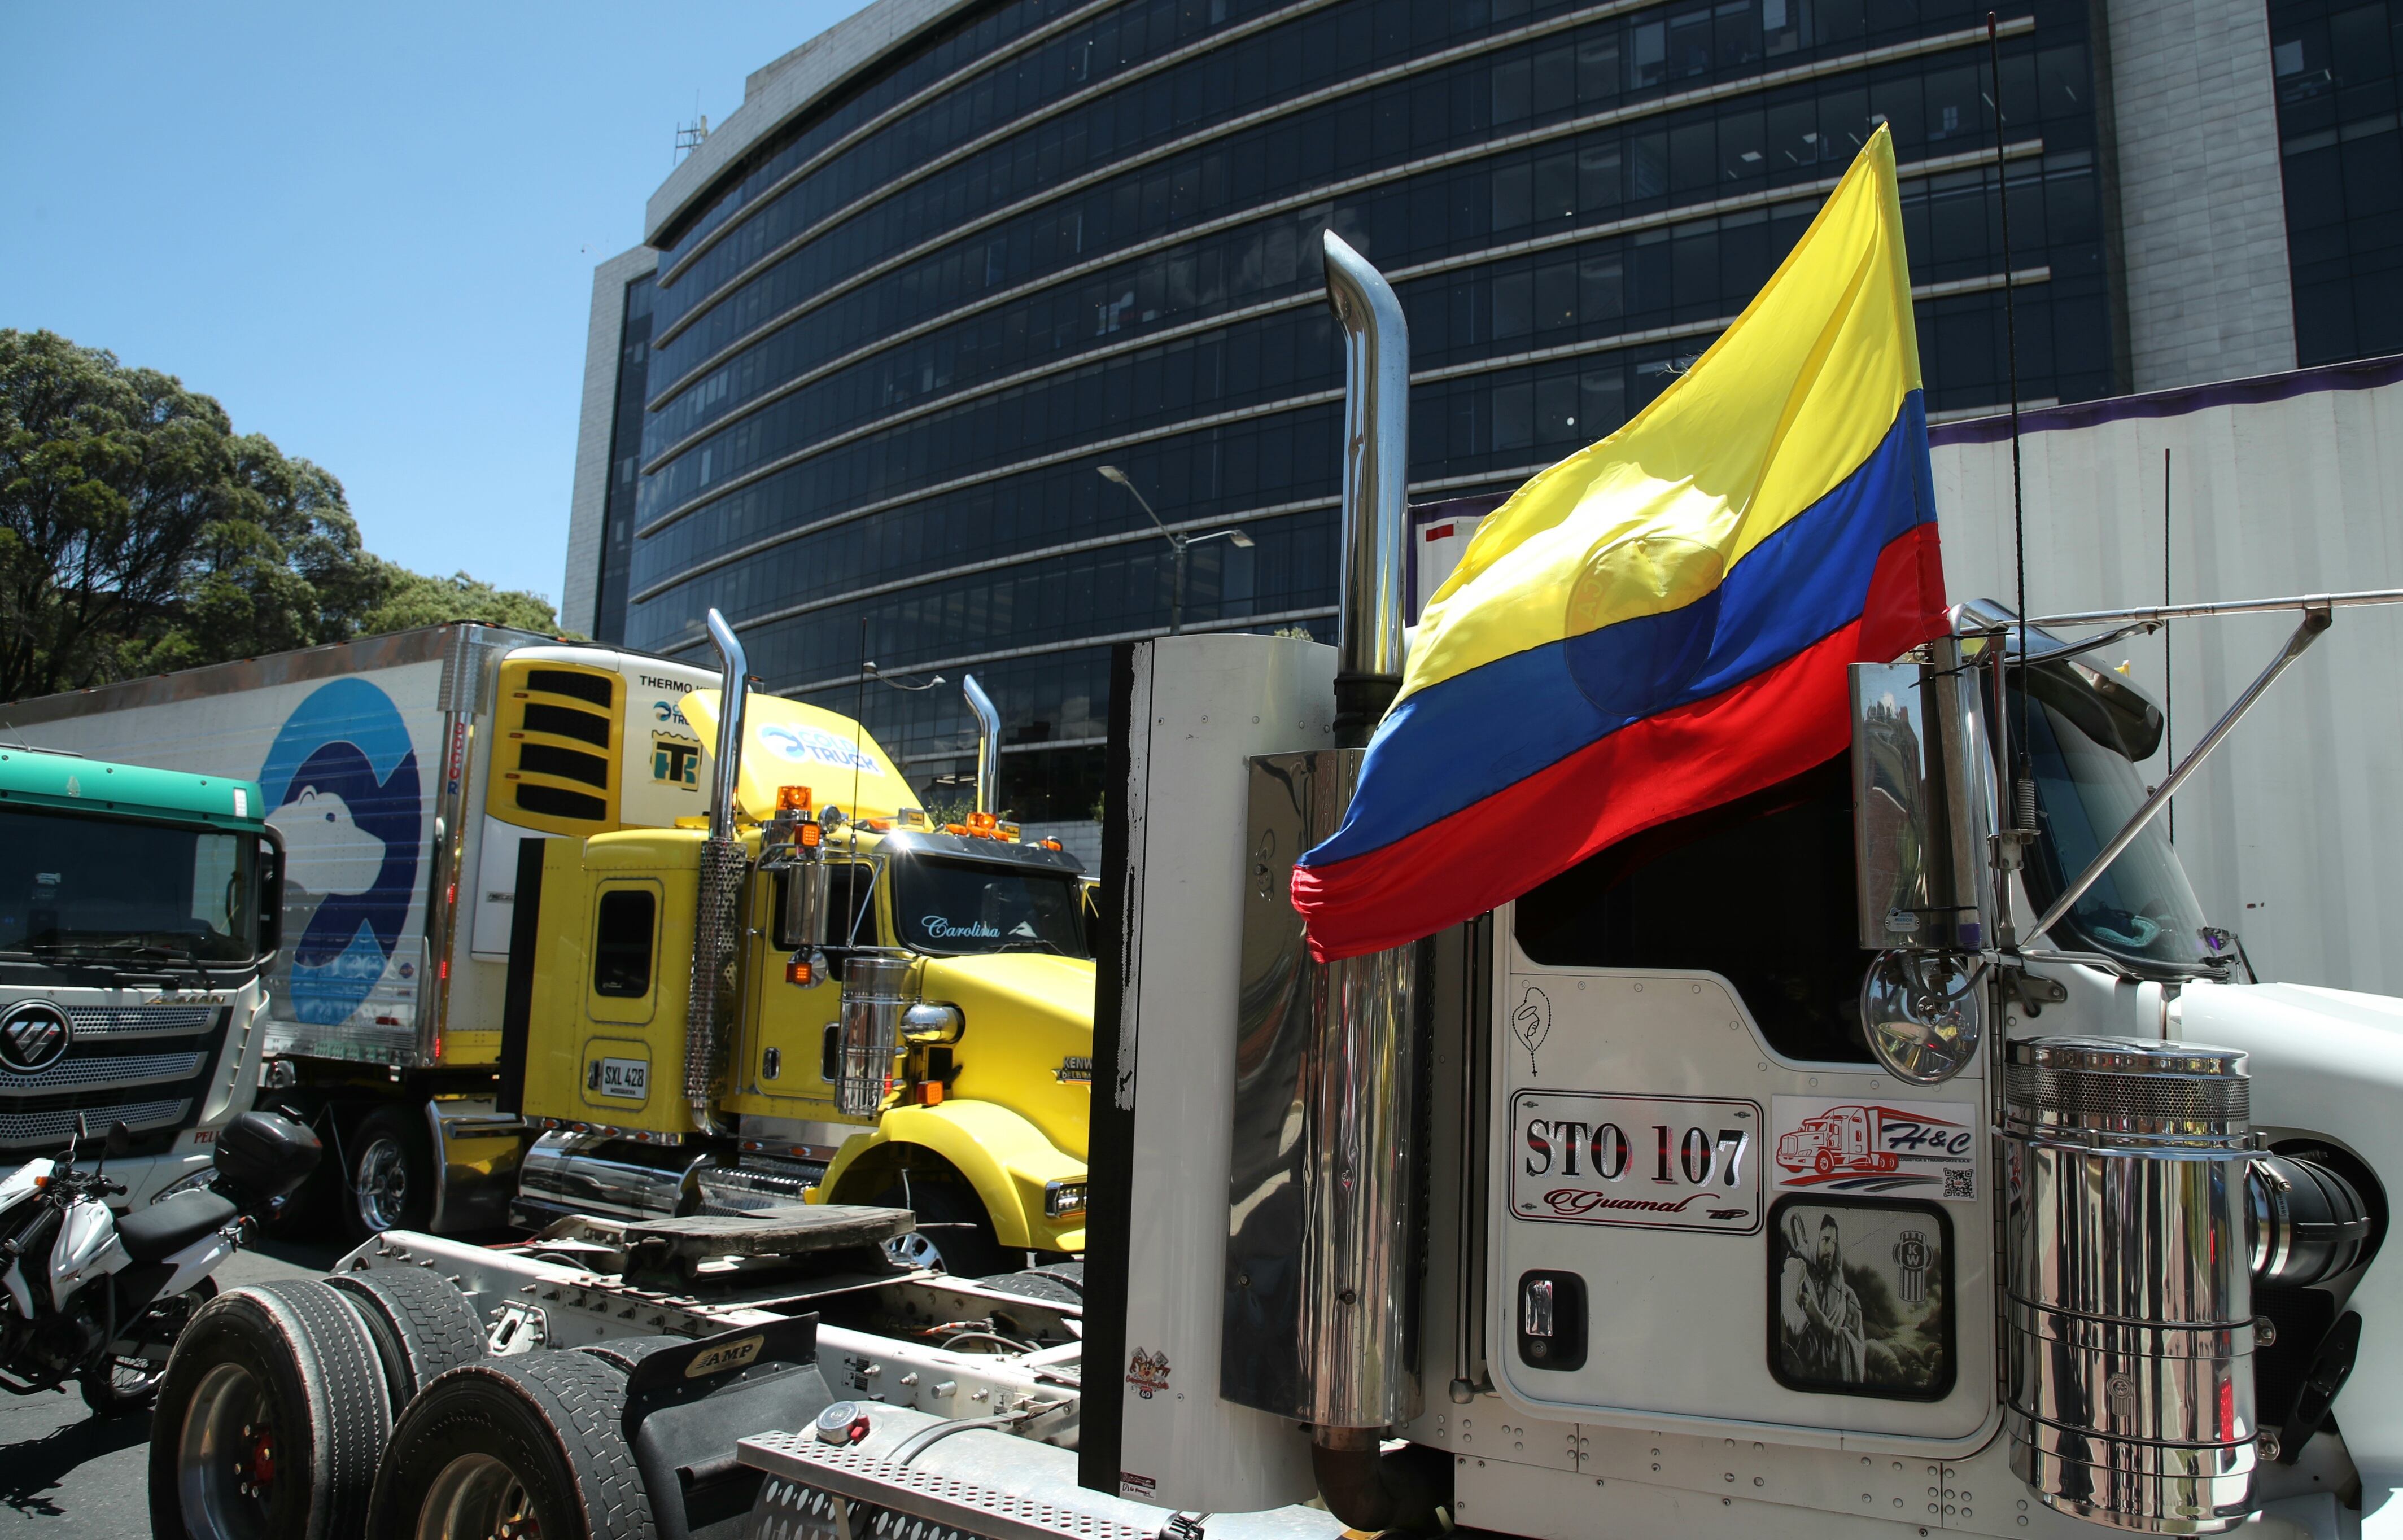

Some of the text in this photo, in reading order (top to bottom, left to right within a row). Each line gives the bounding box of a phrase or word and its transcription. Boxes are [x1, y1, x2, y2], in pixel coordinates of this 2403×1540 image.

[639, 675, 692, 693] THERMO
[798, 731, 858, 753] COLD
[805, 745, 880, 772] TRUCK
[921, 915, 1001, 938] Carolina
[605, 1066, 644, 1088] SXL 428
[1881, 1123, 1972, 1155] H&C
[1526, 1119, 1750, 1189] STO 107
[1543, 1188, 1720, 1215] Guamal
[707, 1344, 753, 1365] AMP
